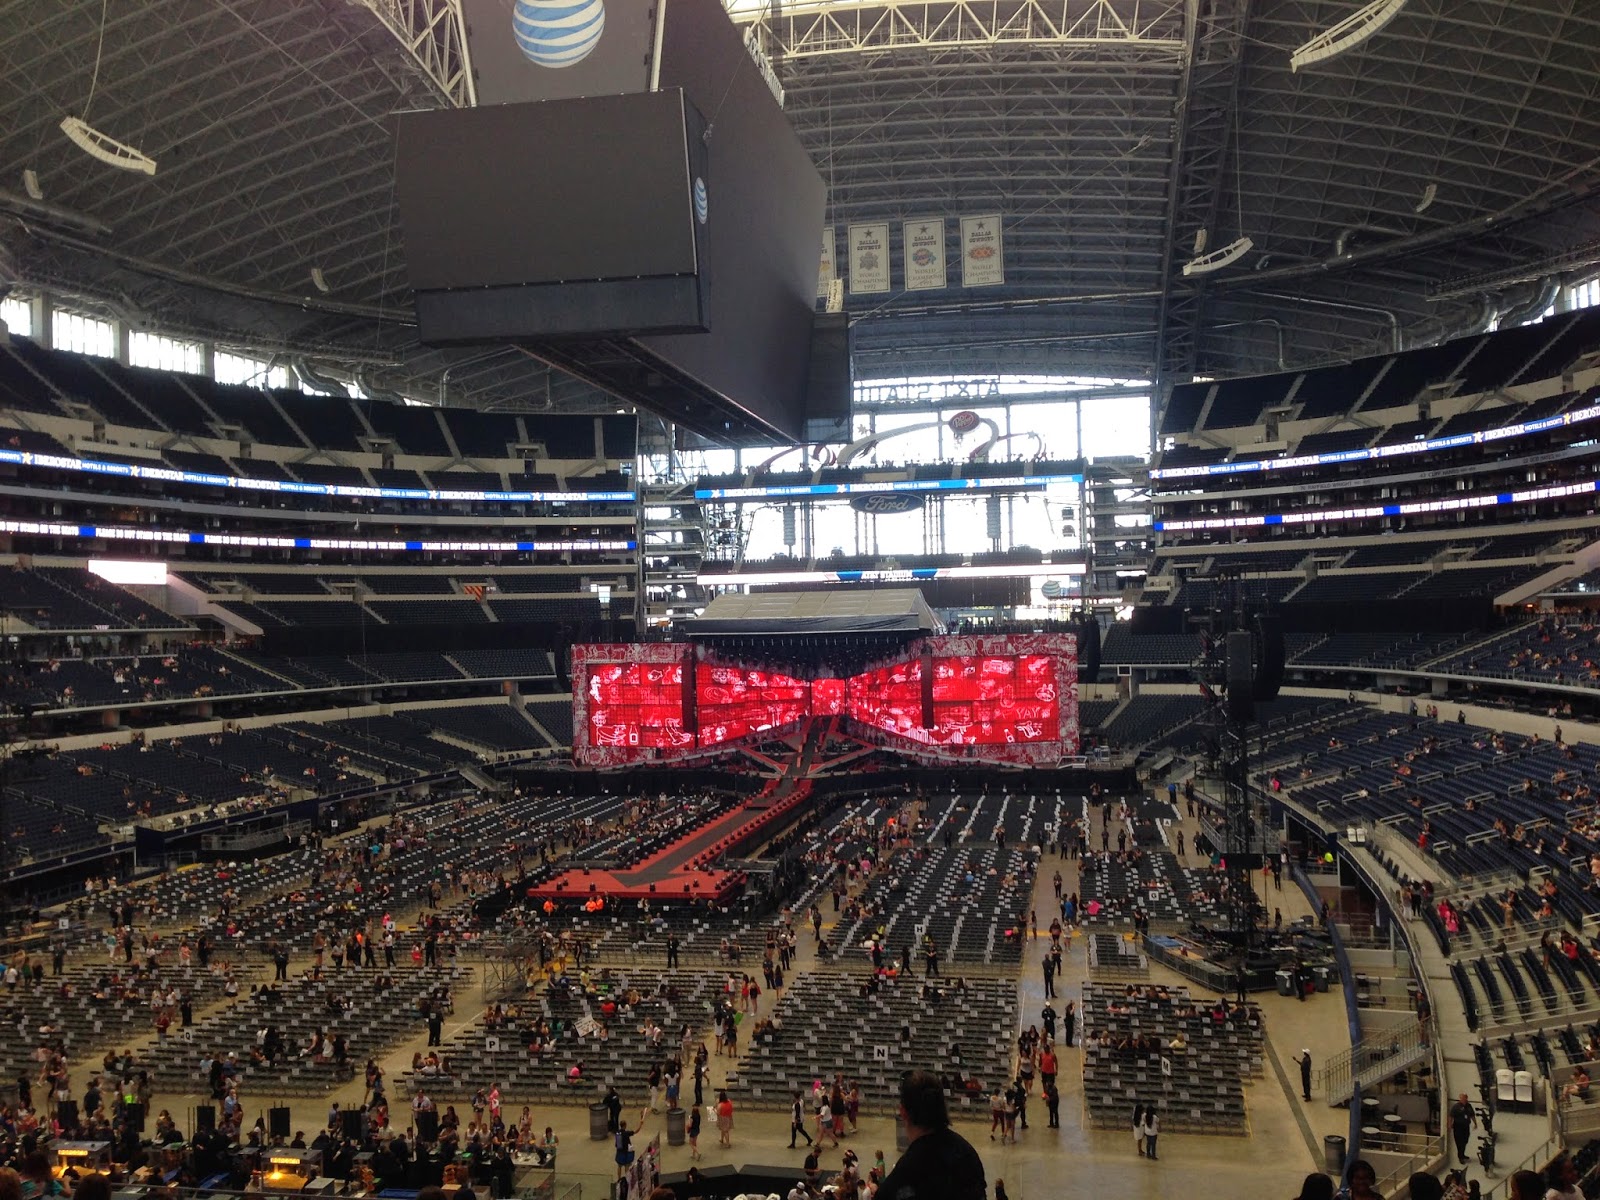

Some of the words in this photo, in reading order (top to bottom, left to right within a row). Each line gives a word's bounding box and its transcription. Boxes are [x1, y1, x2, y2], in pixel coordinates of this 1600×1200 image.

[1485, 425, 1524, 440] IBEROSTAR
[1381, 442, 1427, 455] IBEROSTAR
[34, 454, 81, 469] IBEROSTAR
[1272, 454, 1319, 468] IBEROSTAR
[142, 468, 183, 480] IBEROSTAR
[1162, 466, 1209, 477] IBEROSTAR
[238, 479, 280, 490] IBEROSTAR
[338, 487, 381, 496] IBEROSTAR
[440, 491, 485, 499] IBEROSTAR
[544, 492, 587, 501] IBEROSTAR
[865, 496, 909, 510] Ford
